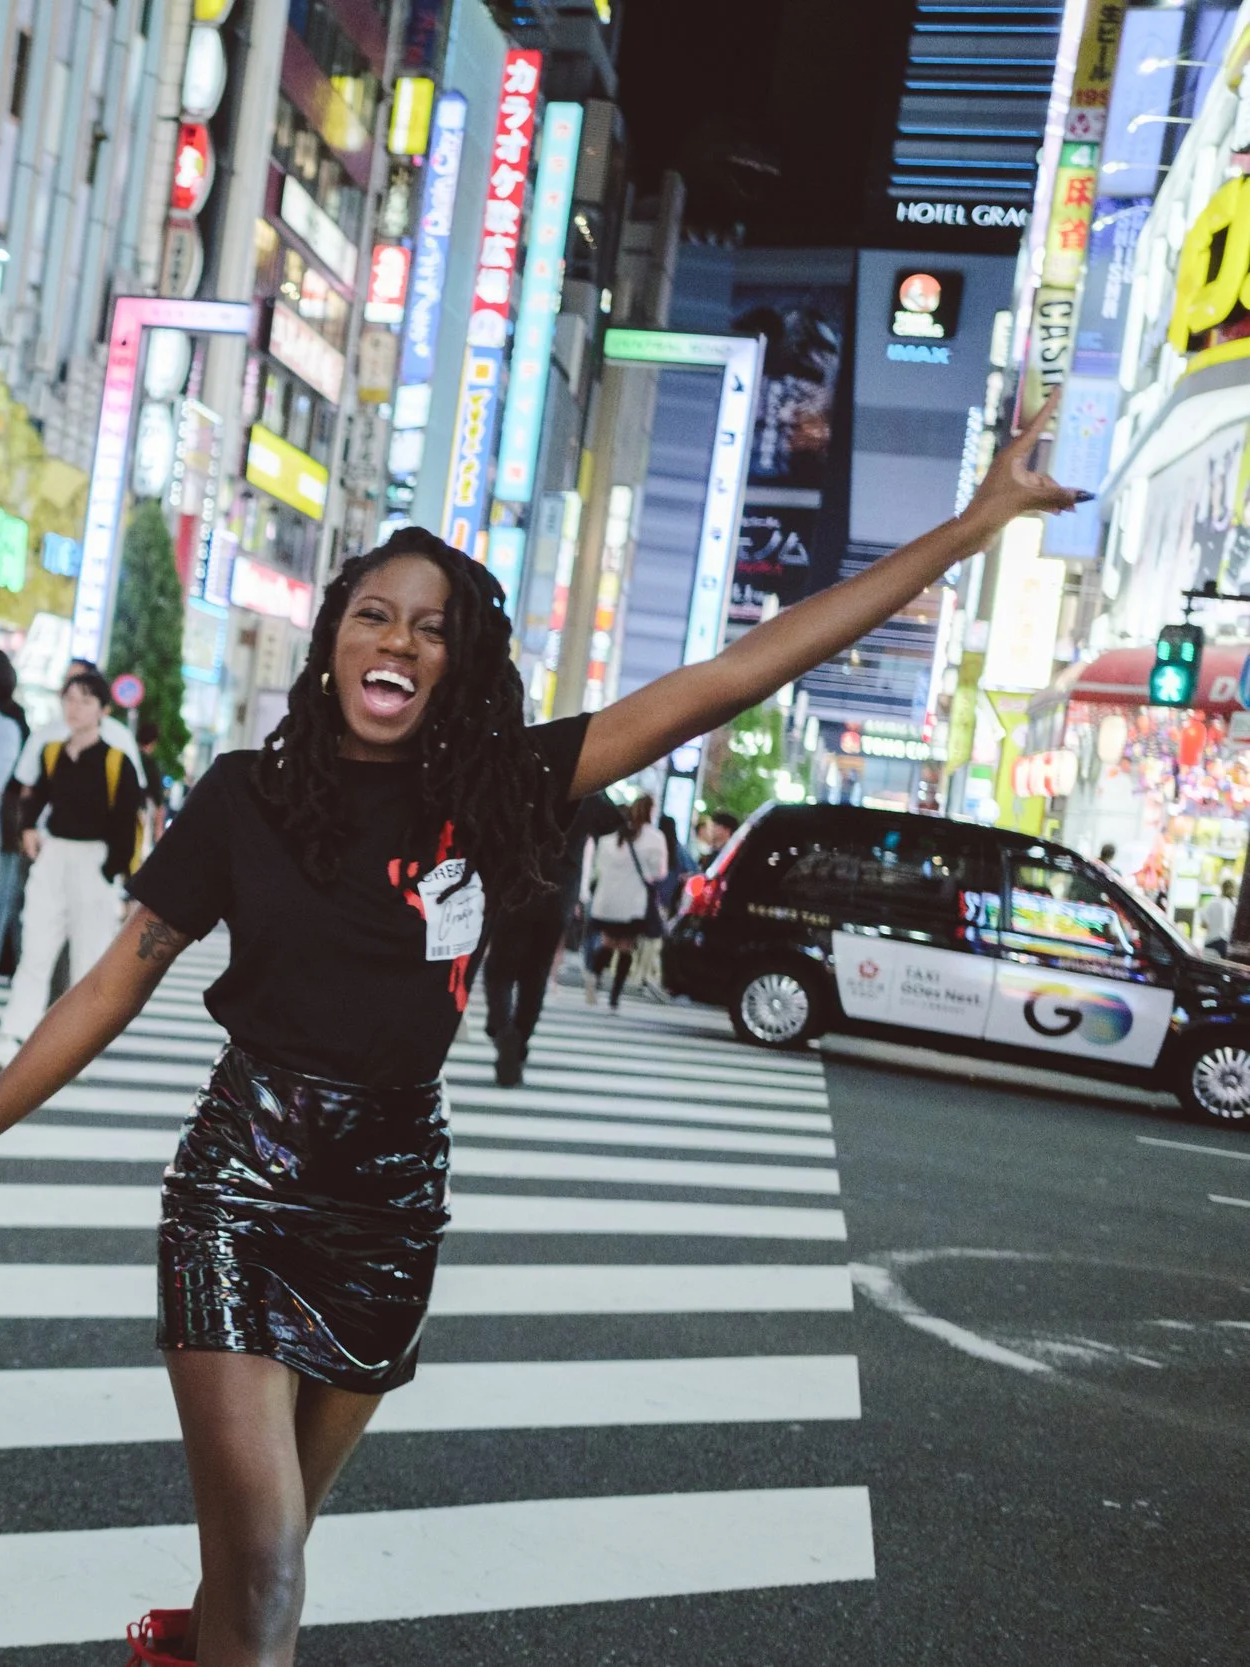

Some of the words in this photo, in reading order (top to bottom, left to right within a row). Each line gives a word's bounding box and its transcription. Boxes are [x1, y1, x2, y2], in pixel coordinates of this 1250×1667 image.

[895, 201, 968, 226] HOTEL
[887, 343, 950, 364] IMAX
[905, 963, 941, 983] TAXI
[943, 987, 981, 1006] Next
